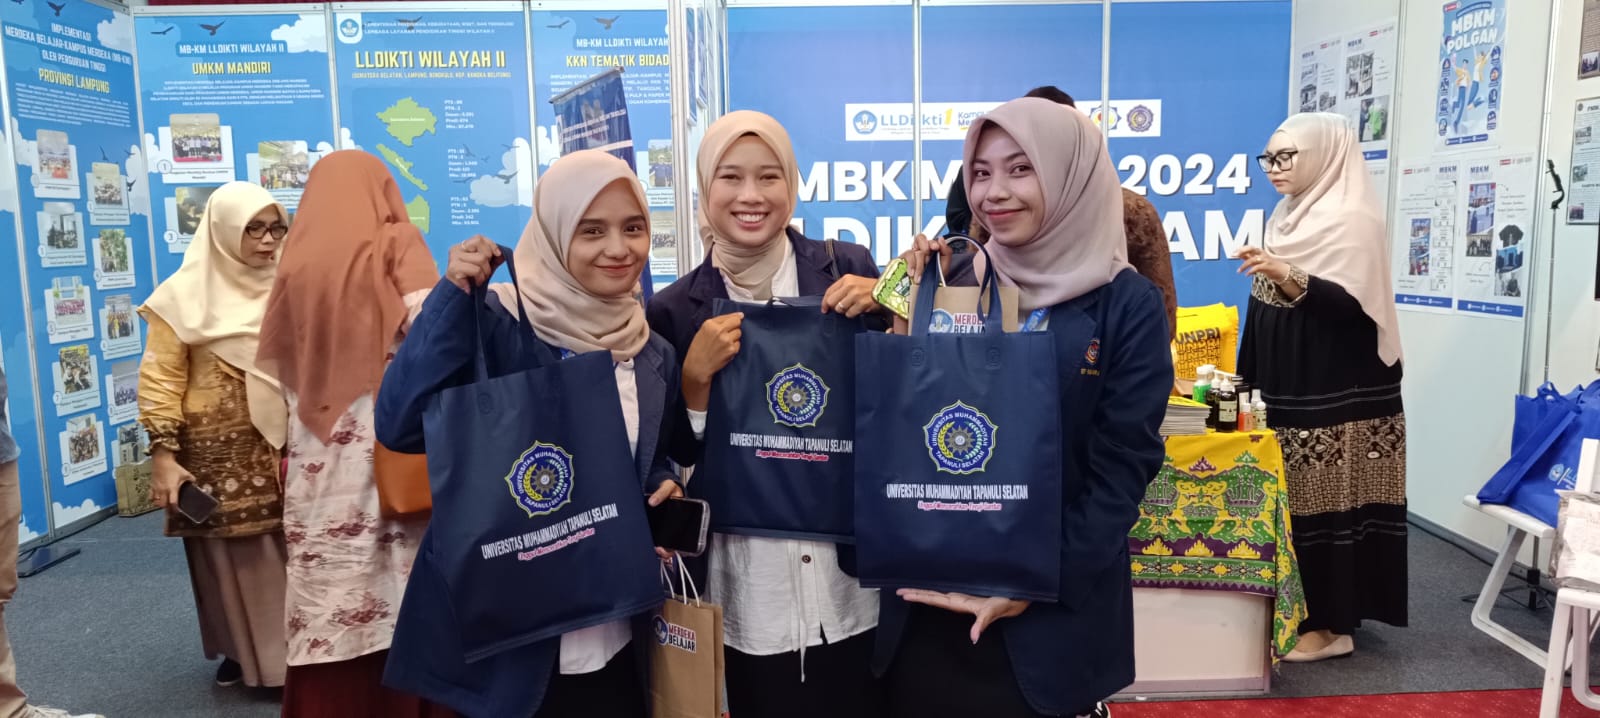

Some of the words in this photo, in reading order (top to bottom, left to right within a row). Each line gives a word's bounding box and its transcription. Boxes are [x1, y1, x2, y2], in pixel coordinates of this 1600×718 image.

[51, 22, 92, 41] IMPLEMENTASI
[1451, 8, 1496, 37] MBKM
[5, 25, 36, 42] MERDEKA
[576, 38, 602, 48] MB-KM
[603, 38, 632, 47] LLDIKTI
[633, 37, 669, 47] WILAYAH
[1447, 28, 1498, 55] POLGAN
[42, 49, 58, 62] OLEH
[179, 44, 207, 54] MB-KM
[208, 43, 239, 54] LLDIKTI
[240, 43, 277, 53] WILAYAH
[192, 62, 225, 75] UMKM
[227, 61, 271, 74] MANDIRI
[355, 50, 415, 68] LLDIKTI
[418, 50, 492, 68] WILAYAH
[496, 50, 506, 67] II
[566, 55, 588, 67] KKN
[591, 55, 636, 67] TEMATIK
[39, 67, 75, 88] PROVINSI
[75, 74, 111, 94] LAMPUNG
[797, 159, 963, 202] MBKM
[1118, 153, 1251, 196] 2024
[1470, 165, 1489, 173] MBKM
[790, 216, 946, 267] DIK
[1175, 327, 1221, 344] UNPRI
[932, 413, 953, 446] UNIVERSITAS
[954, 412, 988, 446] MUHAMMADIYAH
[730, 432, 763, 447] UNIVERSITAS
[763, 435, 805, 450] MUHAMMADIYAH
[805, 438, 830, 452] TAPANULI
[830, 439, 853, 453] SELATAN
[936, 450, 961, 468] TAPANULI
[961, 450, 985, 468] SELATAN
[886, 483, 924, 498] UNIVERSITAS
[925, 484, 971, 499] MUHAMMADIYAH
[973, 485, 1002, 500] TAPANULI
[1002, 484, 1028, 499] SELATAN
[481, 535, 524, 560] UNIVERSITAS
[522, 520, 569, 548] MUHAMMADIYAH
[567, 510, 593, 532] TAPANULI
[591, 503, 619, 523] SELATAN
[668, 622, 695, 641] MERDEKA
[668, 634, 696, 652] BELAJAR
